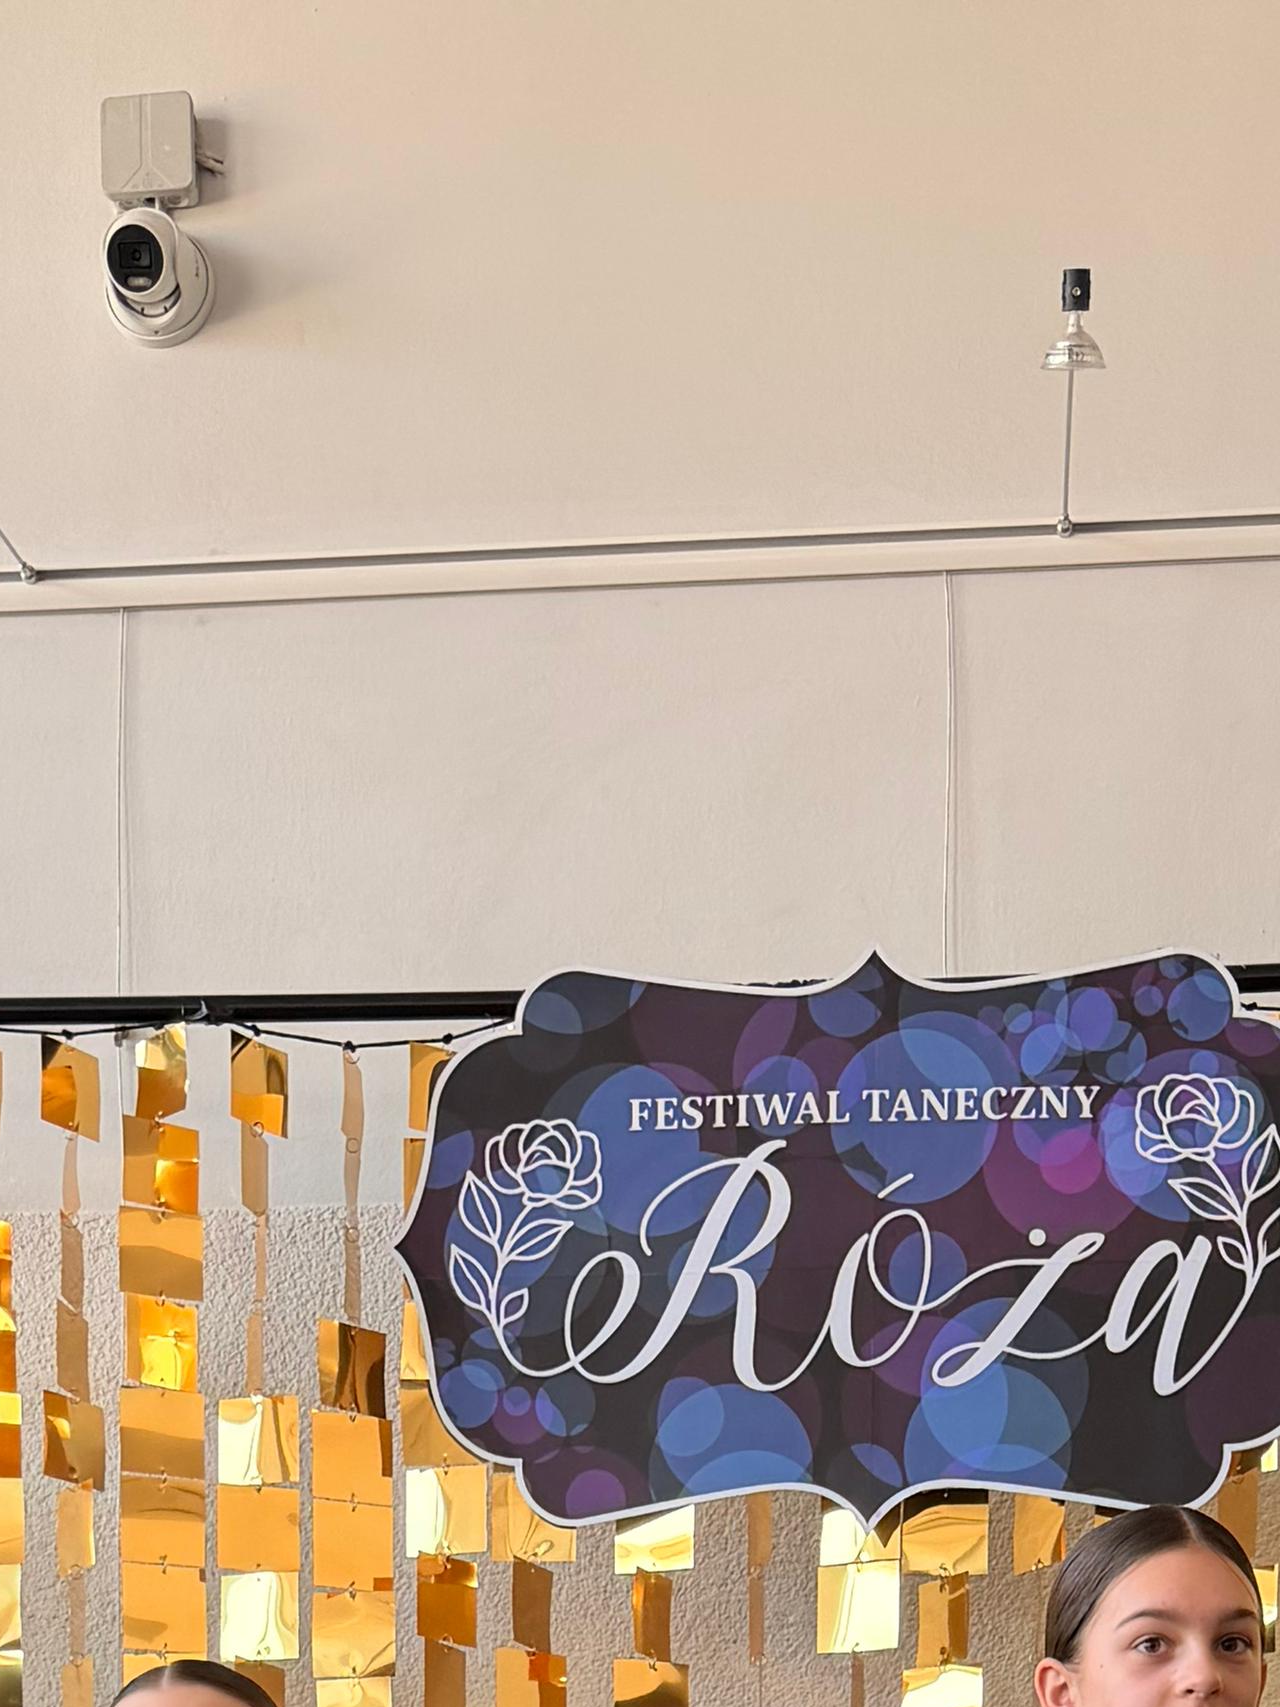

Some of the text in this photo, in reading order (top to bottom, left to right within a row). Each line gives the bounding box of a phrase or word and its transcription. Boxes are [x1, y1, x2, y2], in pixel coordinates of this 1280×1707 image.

[628, 1084, 1102, 1131] FESTIWAL TANECZNY
[567, 1139, 1238, 1396] Róża
